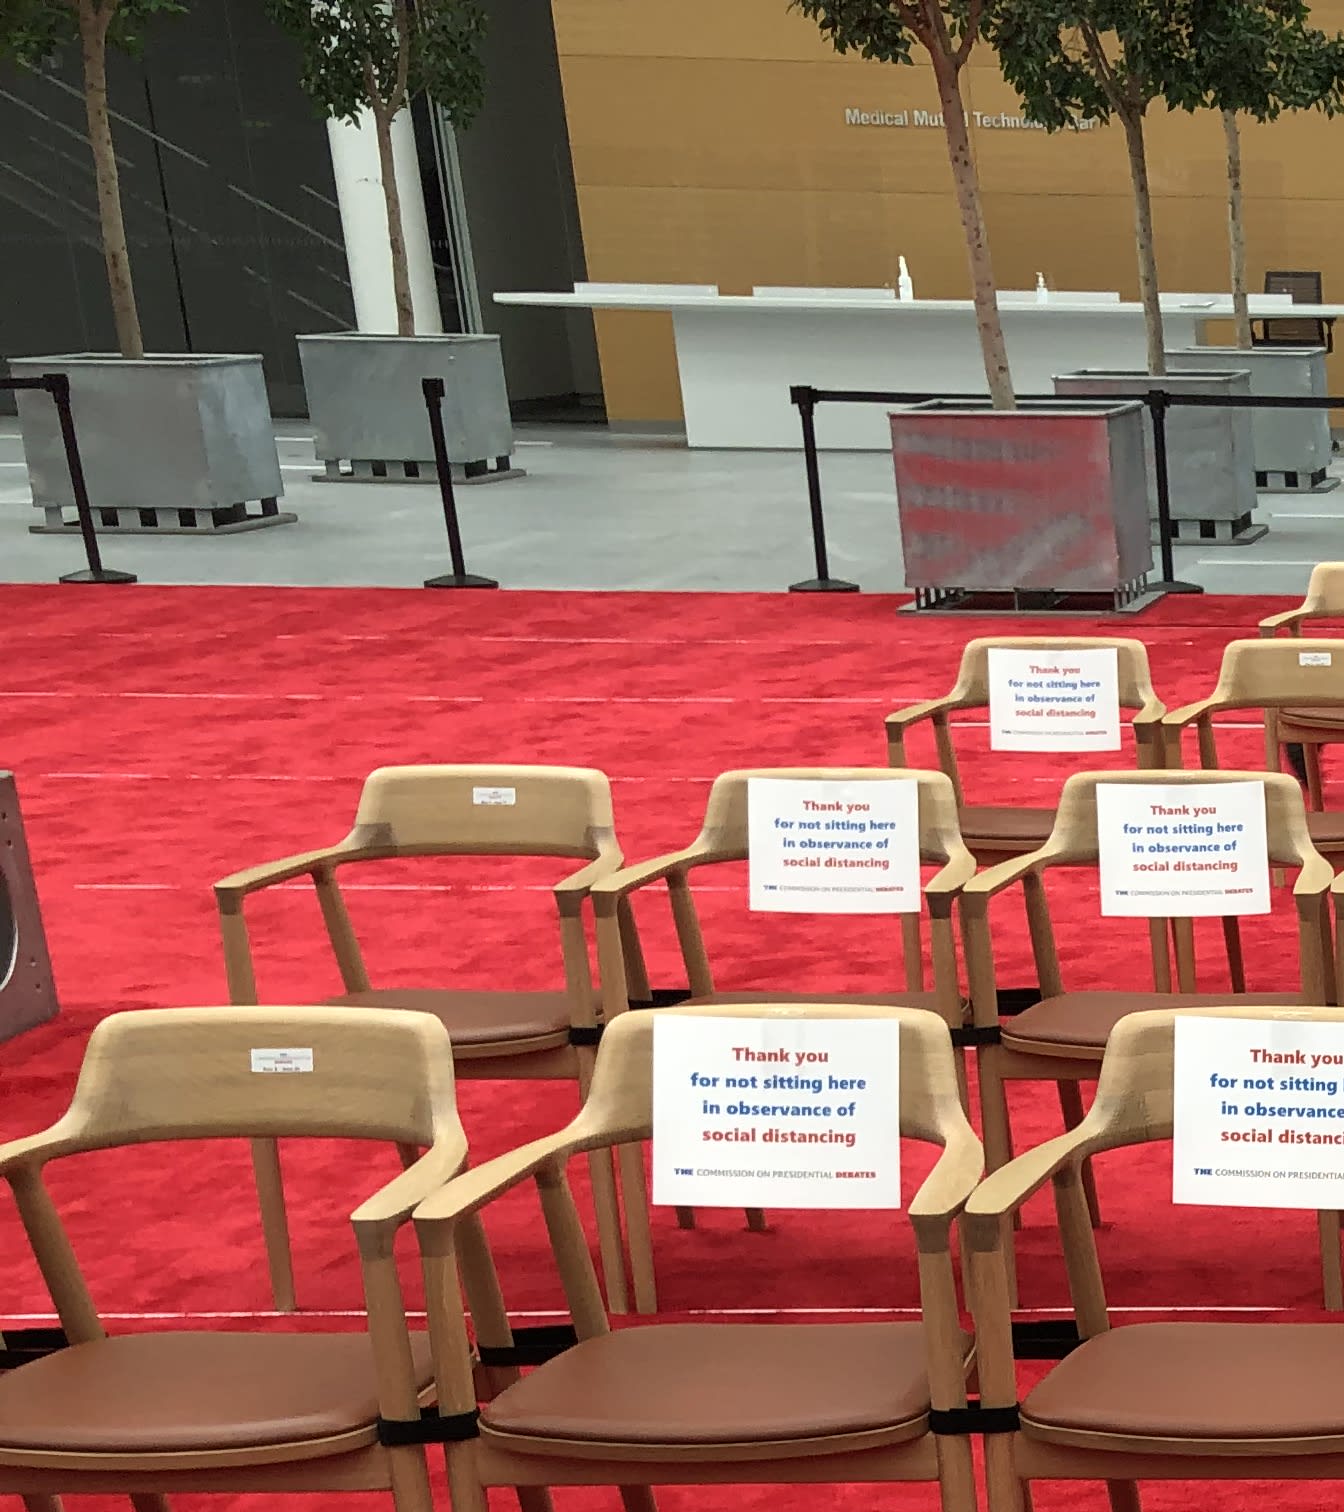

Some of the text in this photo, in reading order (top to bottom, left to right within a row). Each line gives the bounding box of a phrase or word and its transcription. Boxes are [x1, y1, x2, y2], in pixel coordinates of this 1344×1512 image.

[846, 108, 909, 126] Medical
[914, 110, 969, 128] Mutl
[803, 800, 870, 814] Thank you
[774, 818, 896, 833] for not sitting here
[783, 837, 888, 849] in observance of
[783, 857, 890, 870] social distancing
[732, 1047, 828, 1067] Thank you
[1250, 1049, 1343, 1068] Thank you
[690, 1072, 866, 1094] for not sitting here
[1210, 1073, 1238, 1088] for
[1243, 1078, 1274, 1090] not
[1280, 1076, 1338, 1096] sitting
[703, 1100, 856, 1116] in observance of
[1222, 1101, 1238, 1115] in
[702, 1128, 856, 1148] social distancing
[1221, 1128, 1272, 1143] social
[674, 1168, 693, 1176] THE
[697, 1169, 754, 1177] COMMISSION
[773, 1171, 832, 1179] PRESIDENTIAL
[1194, 1168, 1212, 1176] THE
[1215, 1169, 1271, 1178] COMMISSION
